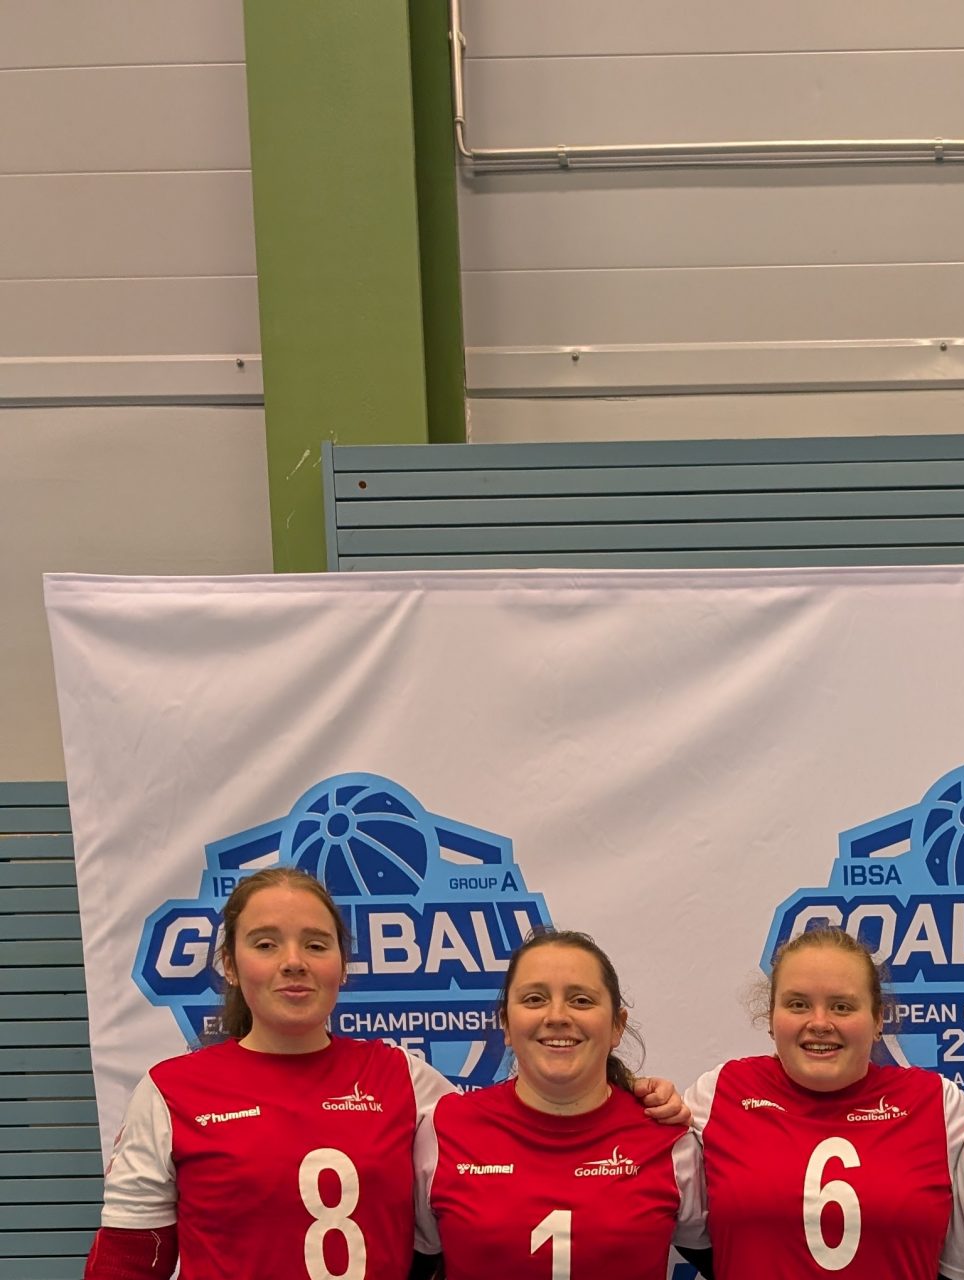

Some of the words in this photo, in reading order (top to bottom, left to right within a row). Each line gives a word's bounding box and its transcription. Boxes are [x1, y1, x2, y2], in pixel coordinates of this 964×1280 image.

[449, 878, 497, 890] GROUP
[501, 871, 518, 892] A
[843, 865, 902, 887] IBSA
[339, 1011, 505, 1032] CHAMPIONSH
[211, 1106, 260, 1123] hummel
[322, 1101, 367, 1112] Goalball
[369, 1103, 383, 1112] UK
[846, 1112, 891, 1122] Goalball
[469, 1163, 514, 1175] hummel
[574, 1165, 623, 1177] Goalball
[624, 1165, 640, 1176] UK
[803, 1136, 862, 1271] 6
